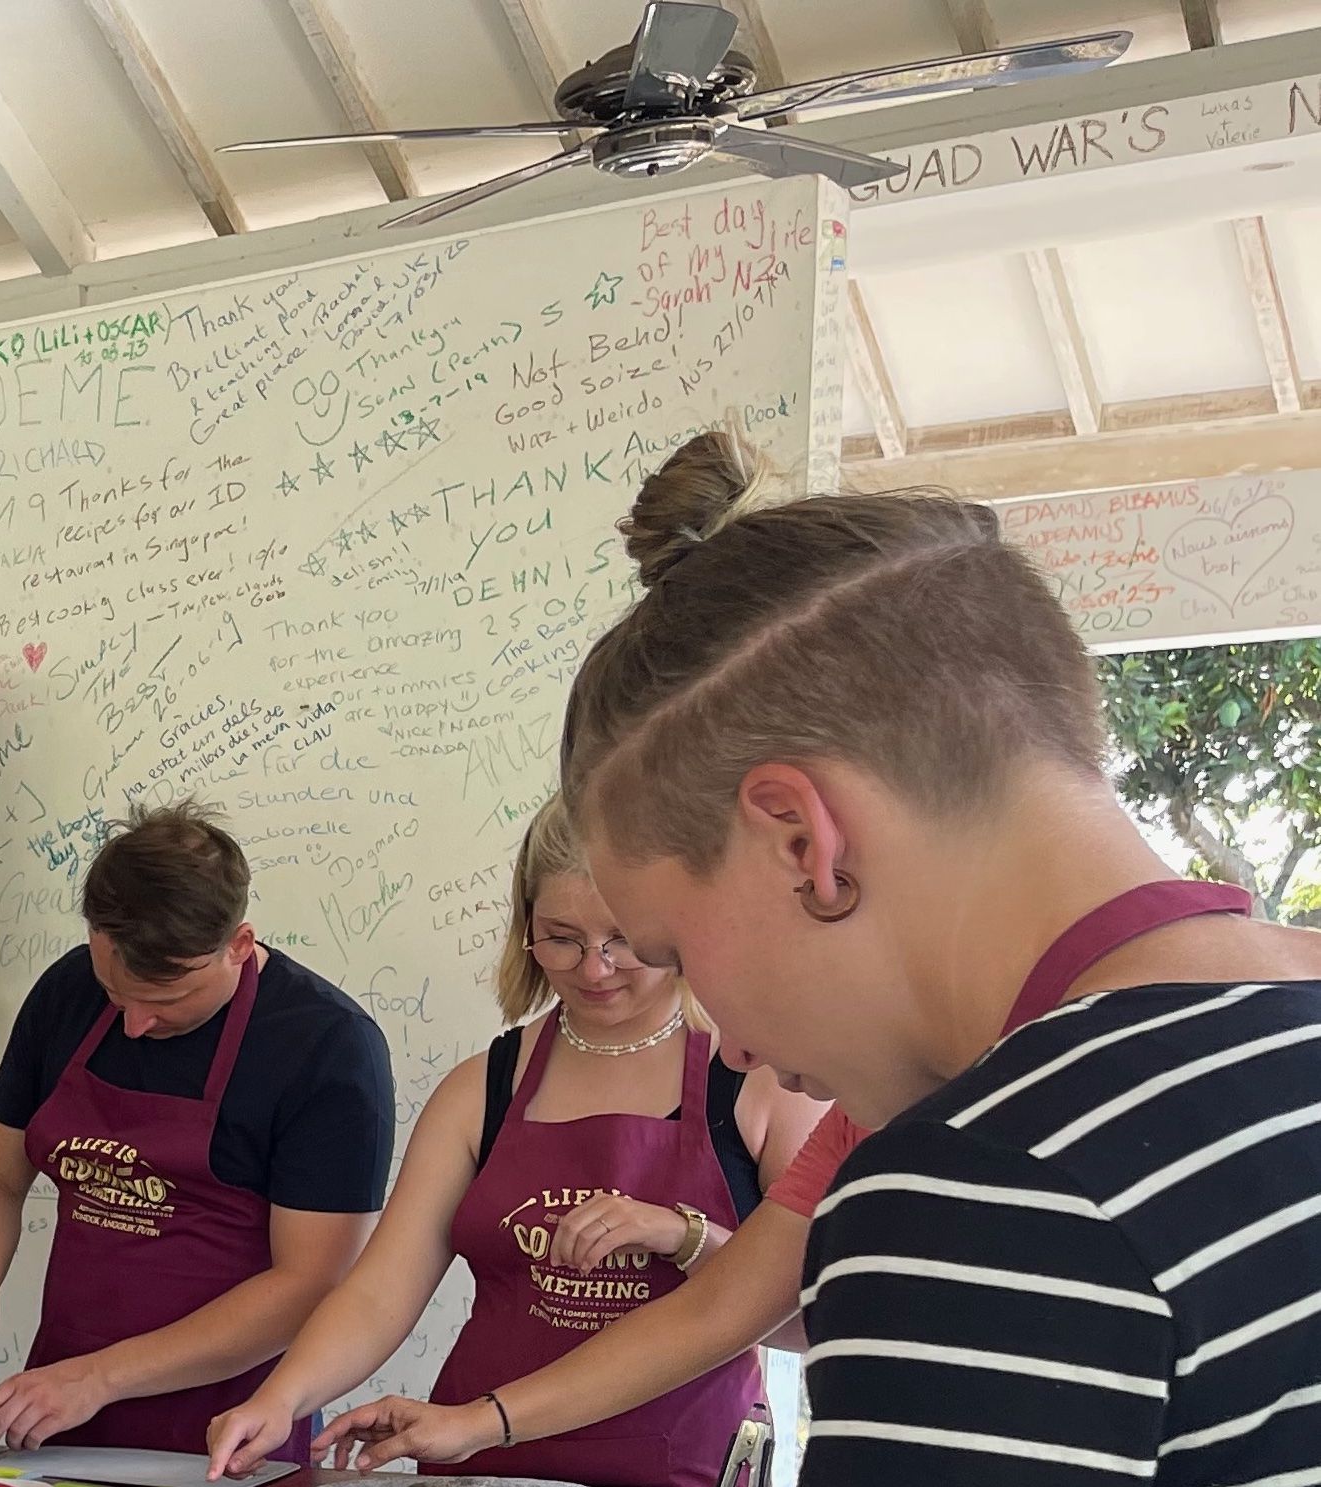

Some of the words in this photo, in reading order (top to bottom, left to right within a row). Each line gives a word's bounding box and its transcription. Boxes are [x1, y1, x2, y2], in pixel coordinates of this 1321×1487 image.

[714, 198, 767, 249] day
[513, 349, 570, 389] Not
[495, 384, 563, 425] Good
[59, 474, 152, 512] Thanks
[431, 450, 614, 523] THANK
[263, 611, 345, 640] Thank
[368, 629, 462, 653] amazing
[428, 864, 498, 902] GREAT
[359, 966, 433, 1025] food
[70, 1136, 119, 1154] LIFE
[115, 1145, 138, 1164] IS
[563, 1309, 598, 1319] LOMBOK
